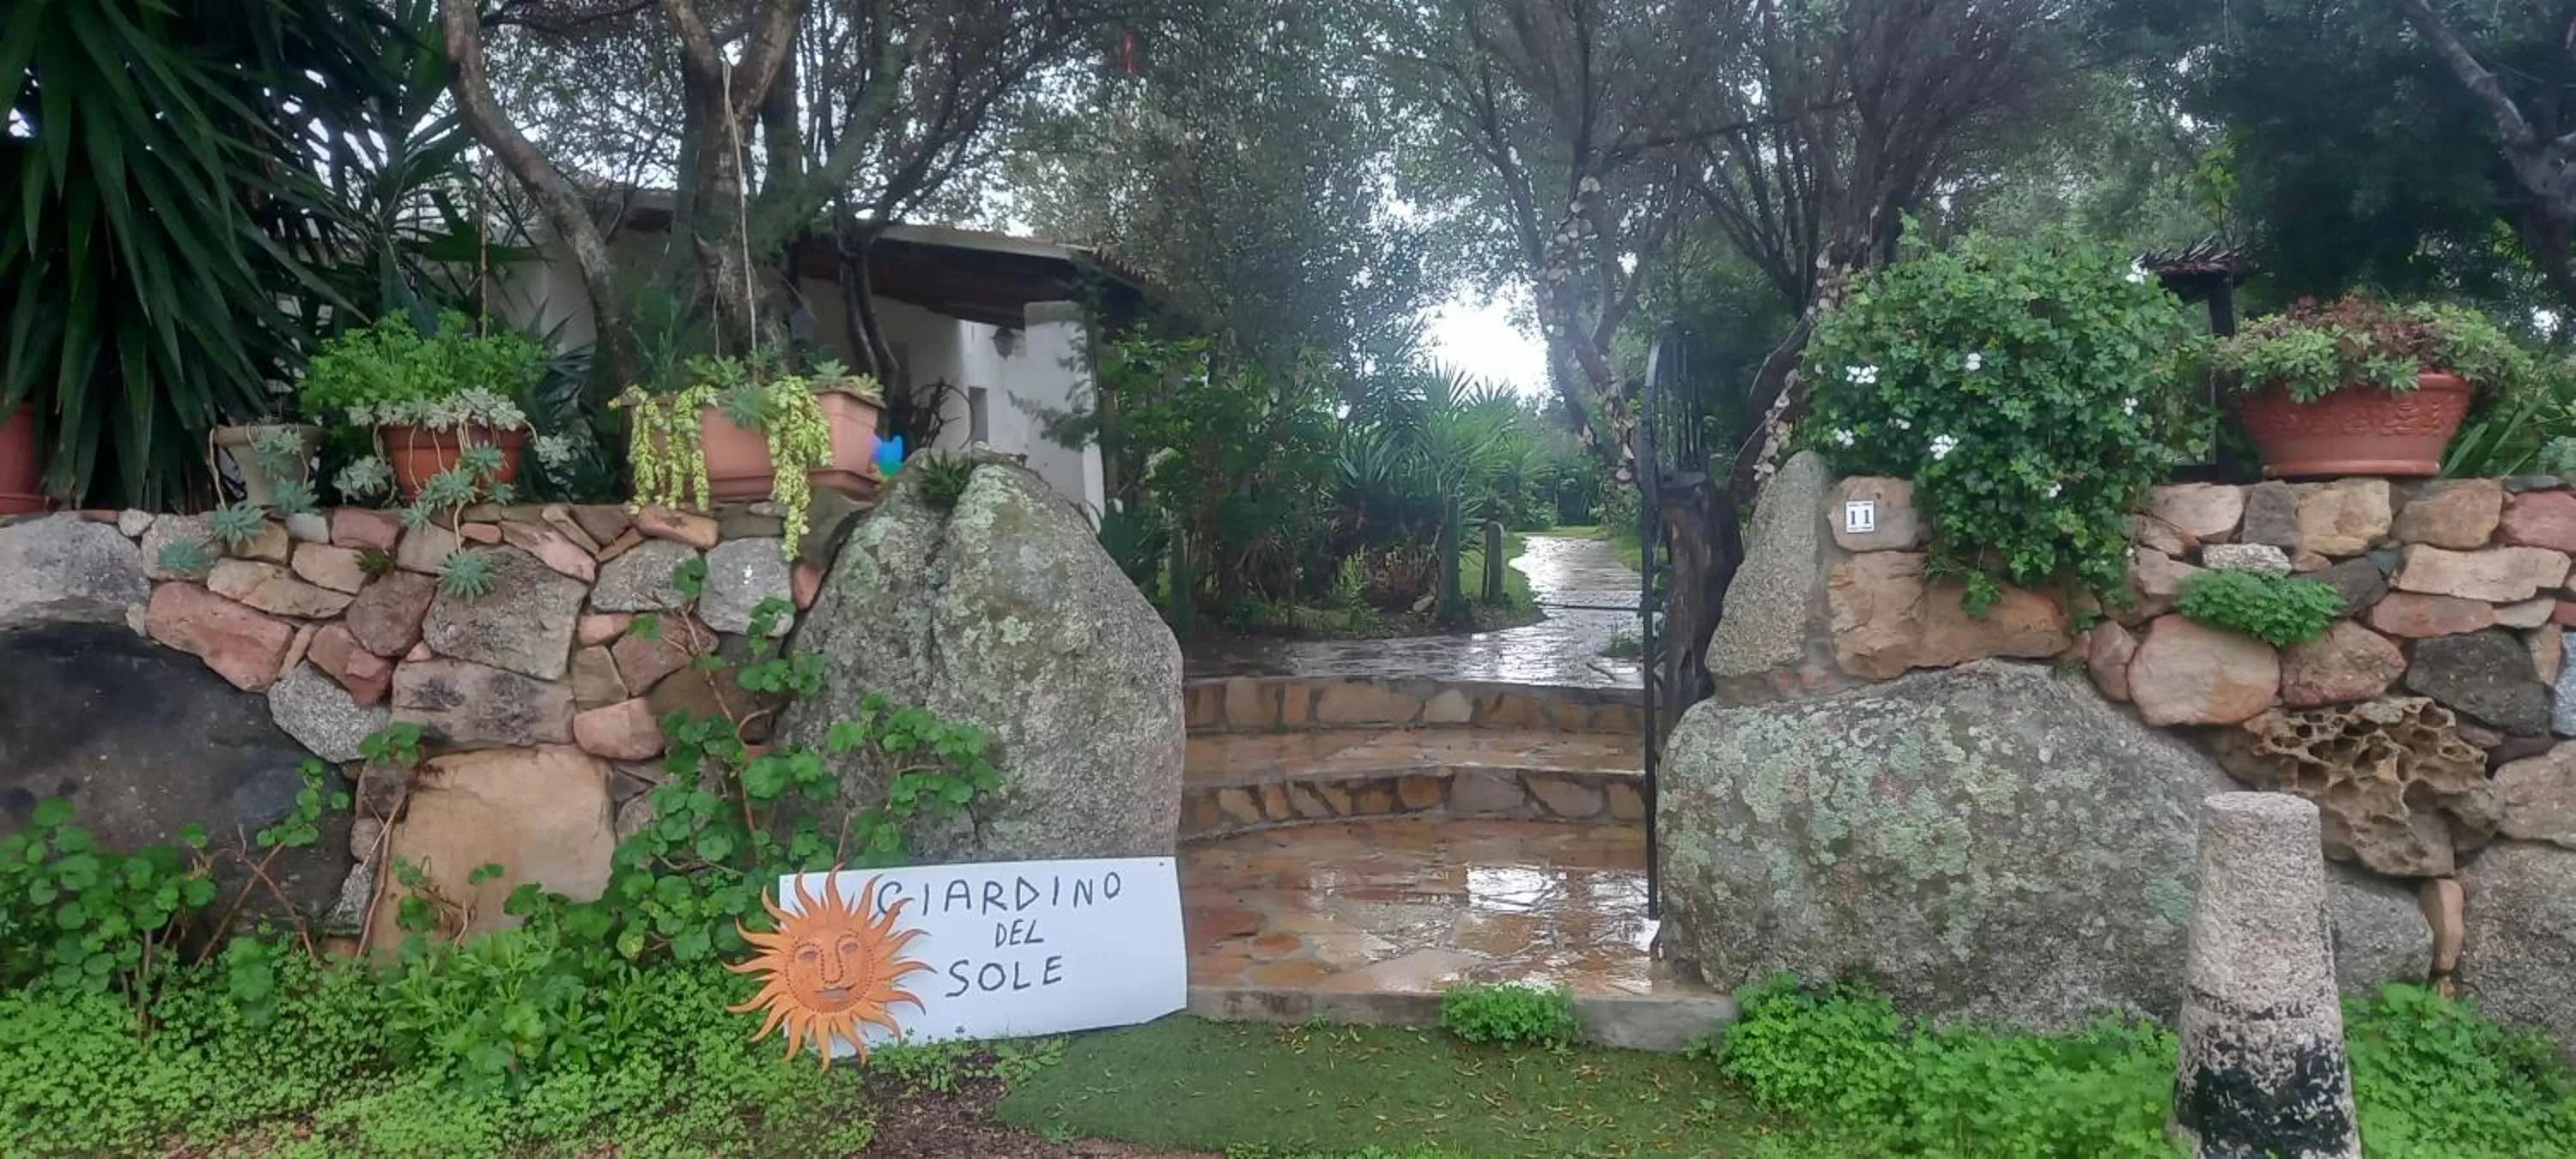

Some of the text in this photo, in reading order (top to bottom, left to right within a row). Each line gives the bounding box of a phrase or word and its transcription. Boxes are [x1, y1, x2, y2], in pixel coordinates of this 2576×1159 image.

[1850, 509, 1870, 525] 11
[994, 919, 1045, 948] DEL
[945, 956, 1063, 998] SOLE
